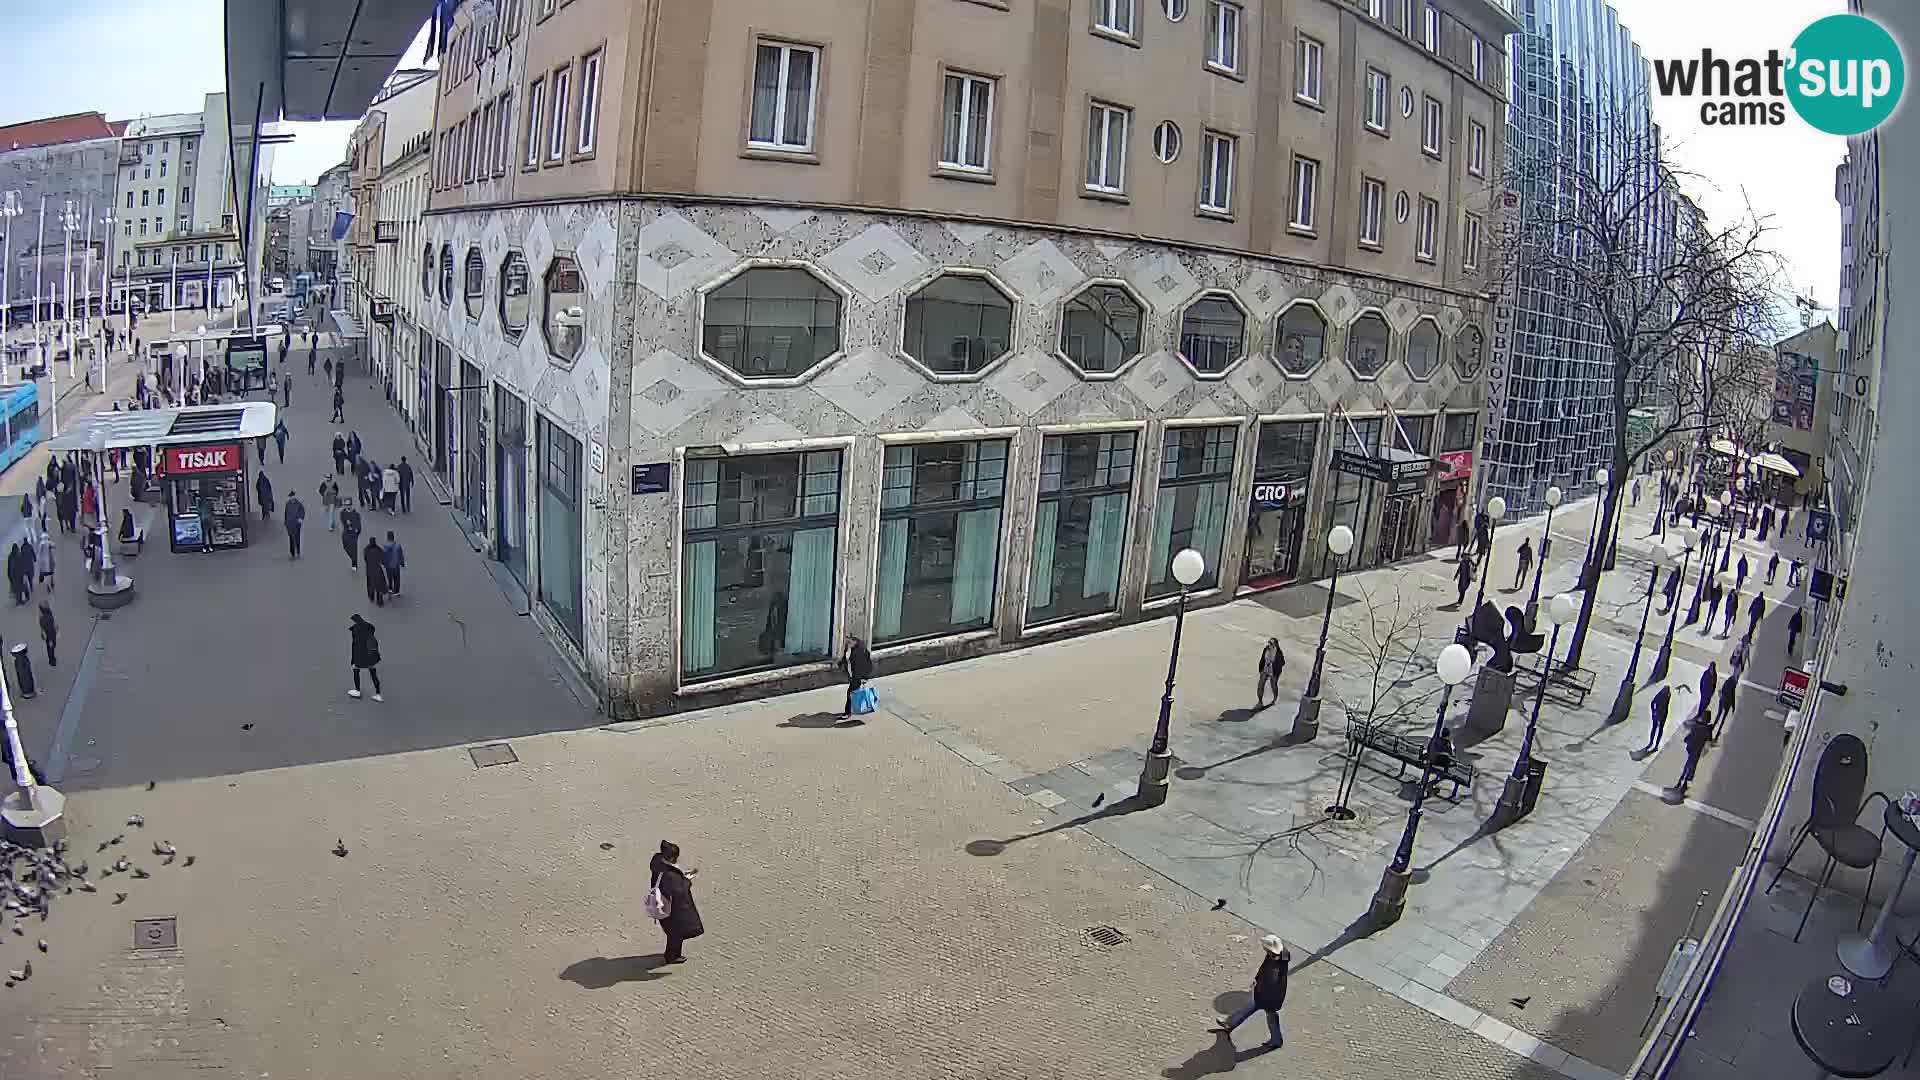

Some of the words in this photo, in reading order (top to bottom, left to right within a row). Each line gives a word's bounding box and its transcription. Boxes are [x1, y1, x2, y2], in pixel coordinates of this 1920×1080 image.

[1484, 306, 1510, 442] DUBROVNIK
[178, 450, 227, 469] TISAK
[1254, 485, 1286, 501] CRO
